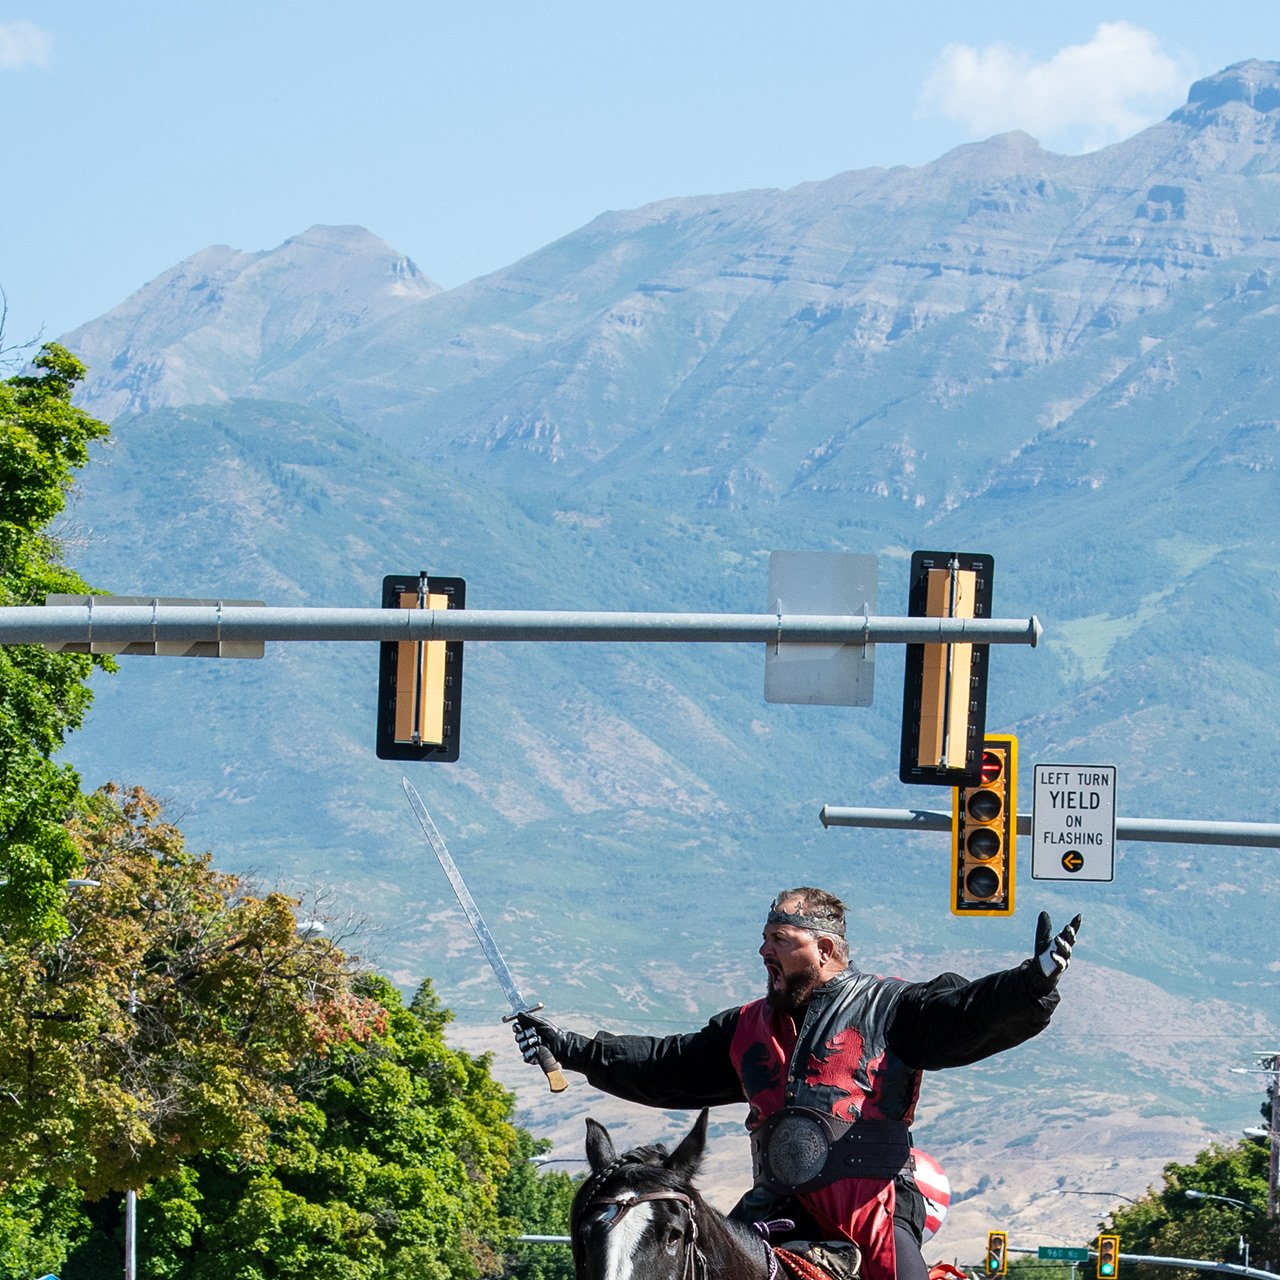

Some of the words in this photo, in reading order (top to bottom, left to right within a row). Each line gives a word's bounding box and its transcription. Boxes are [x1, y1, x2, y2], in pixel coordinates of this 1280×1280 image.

[1041, 772, 1070, 785] LEFT
[1078, 773, 1109, 786] TURN
[1049, 790, 1100, 810] YIELD
[1065, 815, 1082, 828] ON
[1043, 831, 1103, 846] FLASHING
[1047, 1248, 1064, 1258] 960
